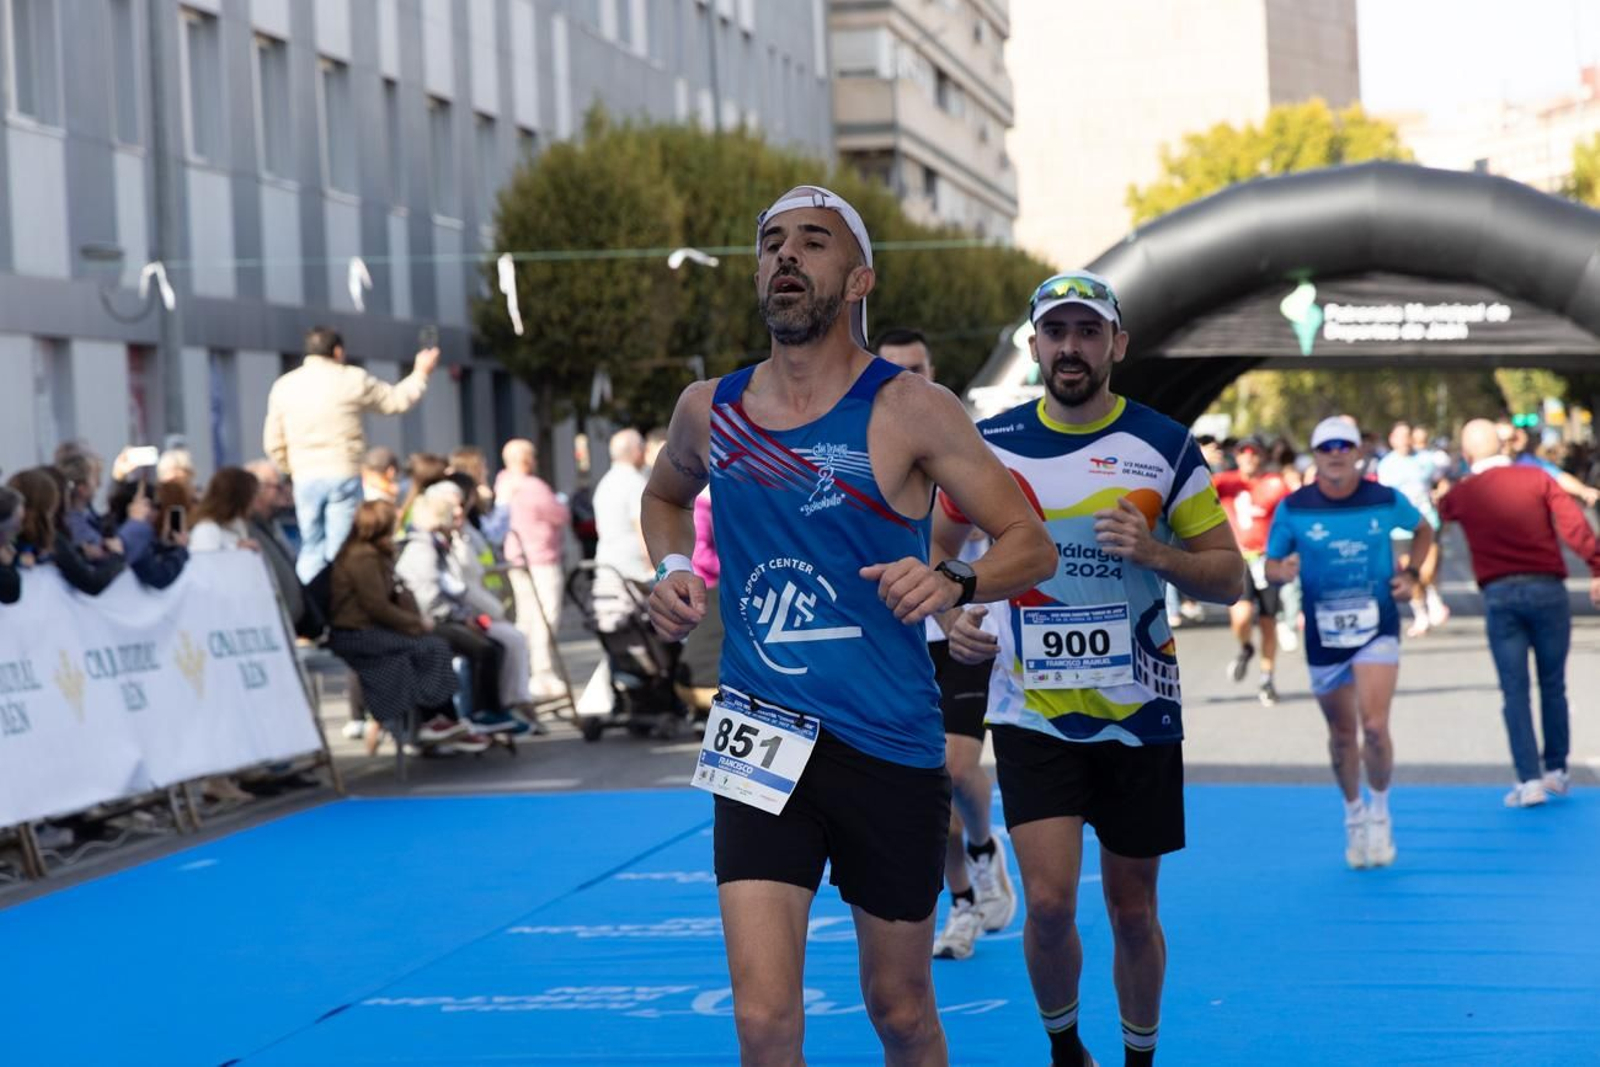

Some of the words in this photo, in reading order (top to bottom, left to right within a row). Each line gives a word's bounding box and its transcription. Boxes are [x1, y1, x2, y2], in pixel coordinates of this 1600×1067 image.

[1404, 303, 1486, 322] Municipal
[1486, 303, 1512, 322] de
[1323, 322, 1400, 343] Deportes
[1400, 323, 1425, 340] de
[769, 558, 814, 575] CENTER
[1065, 562, 1123, 581] 2024
[1334, 614, 1358, 630] 82
[1043, 629, 1111, 657] 900
[714, 717, 783, 769] 851
[718, 756, 754, 775] FRANCISCO
